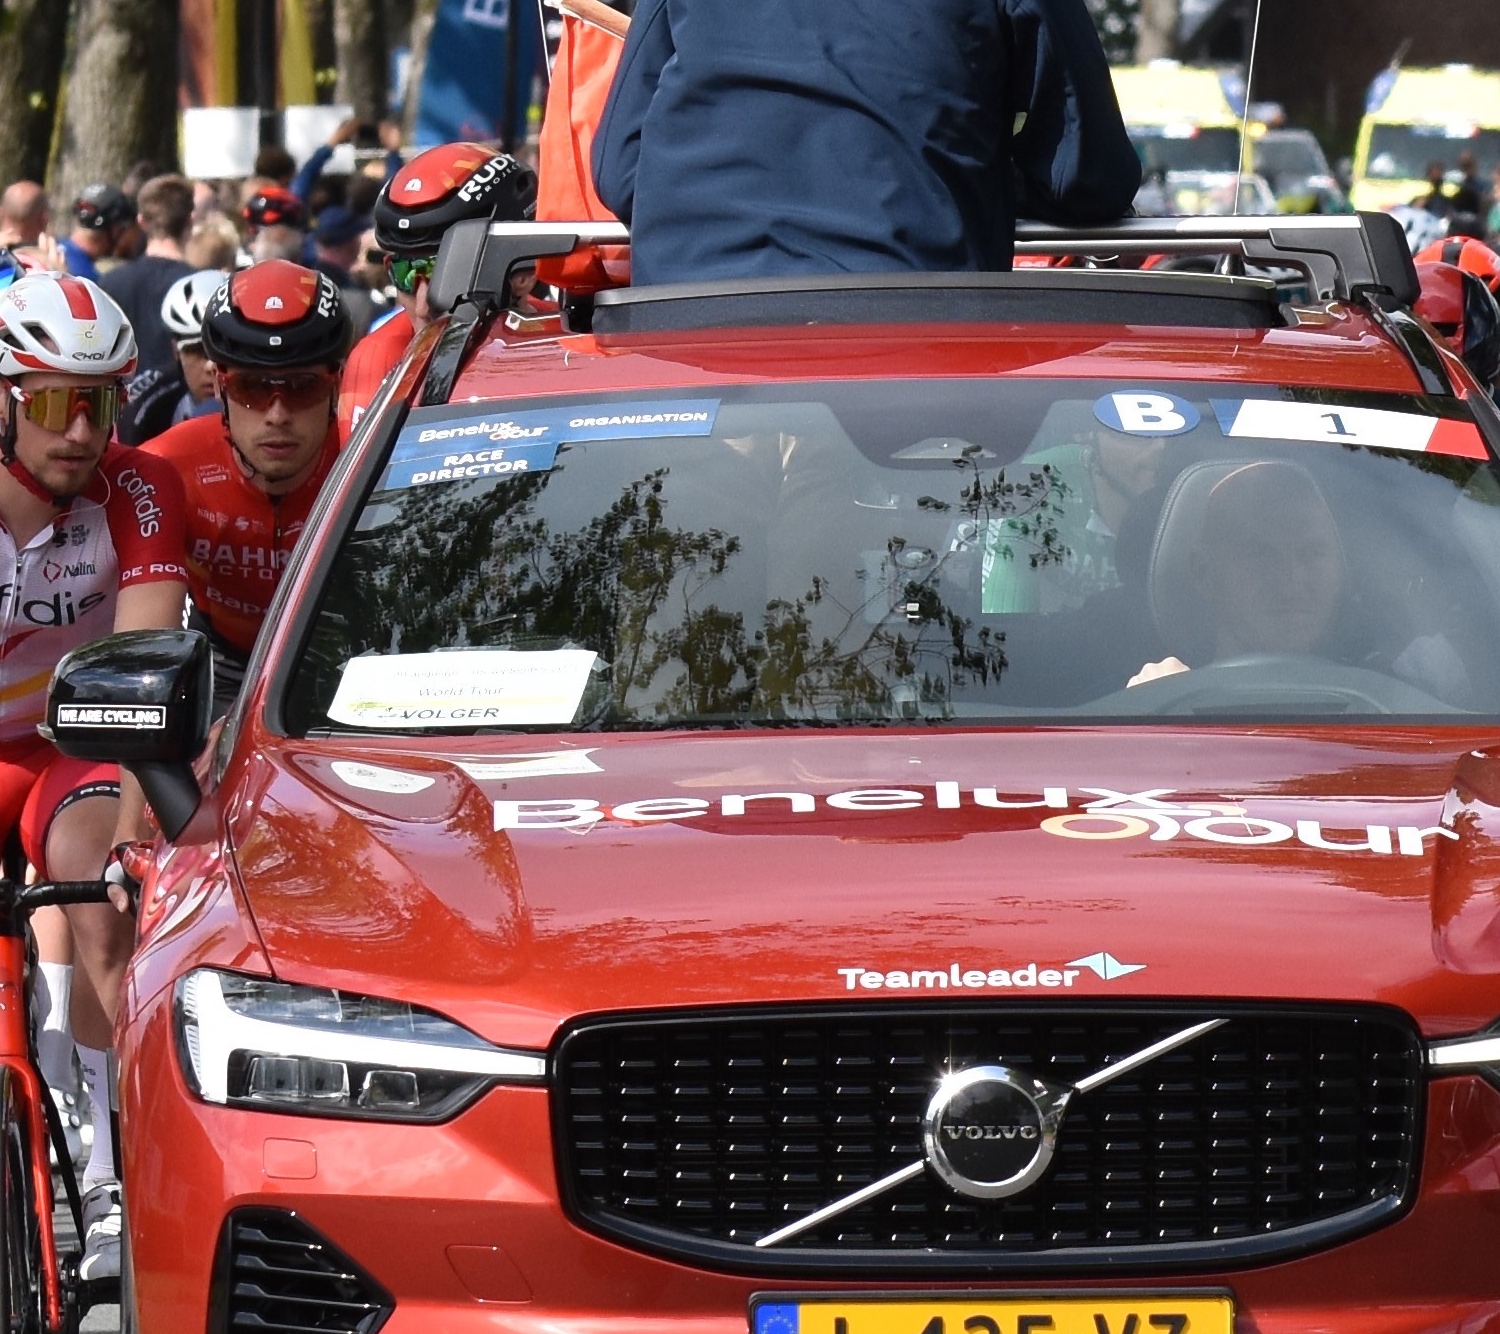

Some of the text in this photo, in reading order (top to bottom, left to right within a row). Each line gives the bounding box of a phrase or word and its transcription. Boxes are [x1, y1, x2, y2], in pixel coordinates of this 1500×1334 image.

[457, 153, 516, 203] RUDY
[569, 412, 708, 429] ORGANISATION
[1112, 392, 1357, 437] B 1
[418, 421, 514, 443] Benelux
[443, 449, 505, 467] RACE
[412, 459, 528, 485] DIRECTOR
[117, 468, 165, 538] Cofidis
[192, 538, 294, 568] BAHR
[63, 560, 96, 577] Nalini
[149, 563, 189, 578] ROS
[61, 709, 161, 724] WE ARE CYCLING
[494, 780, 1188, 833] Benelux
[1145, 802, 1460, 857] Tour
[838, 963, 1080, 991] Teamleader
[945, 1123, 1039, 1142] VOLVO
